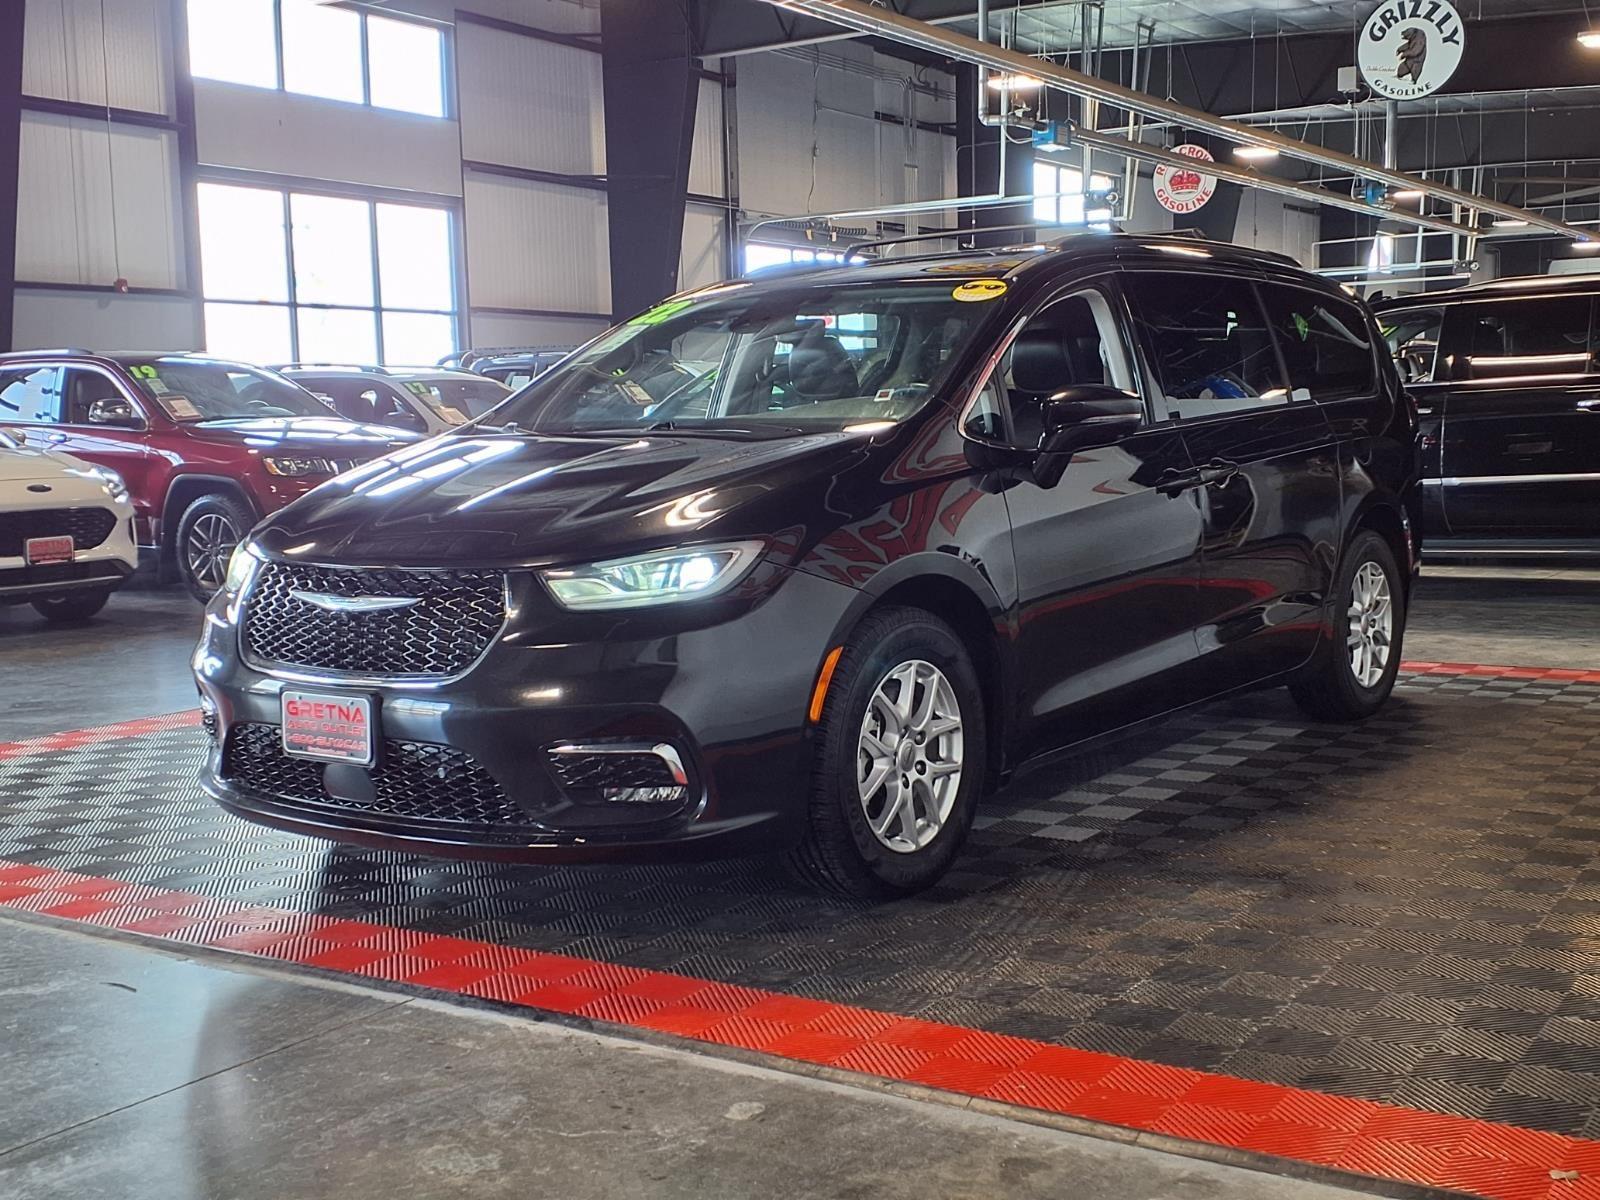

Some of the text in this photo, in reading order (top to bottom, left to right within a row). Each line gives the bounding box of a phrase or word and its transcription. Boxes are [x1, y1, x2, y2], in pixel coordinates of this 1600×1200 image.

[1369, 0, 1460, 46] GRIZZLY
[1374, 79, 1433, 96] GASOLINE
[1156, 187, 1212, 212] GASOLINE
[129, 365, 157, 379] 19
[286, 700, 365, 723] GRETNA
[287, 720, 367, 737] AUTO OUTLET
